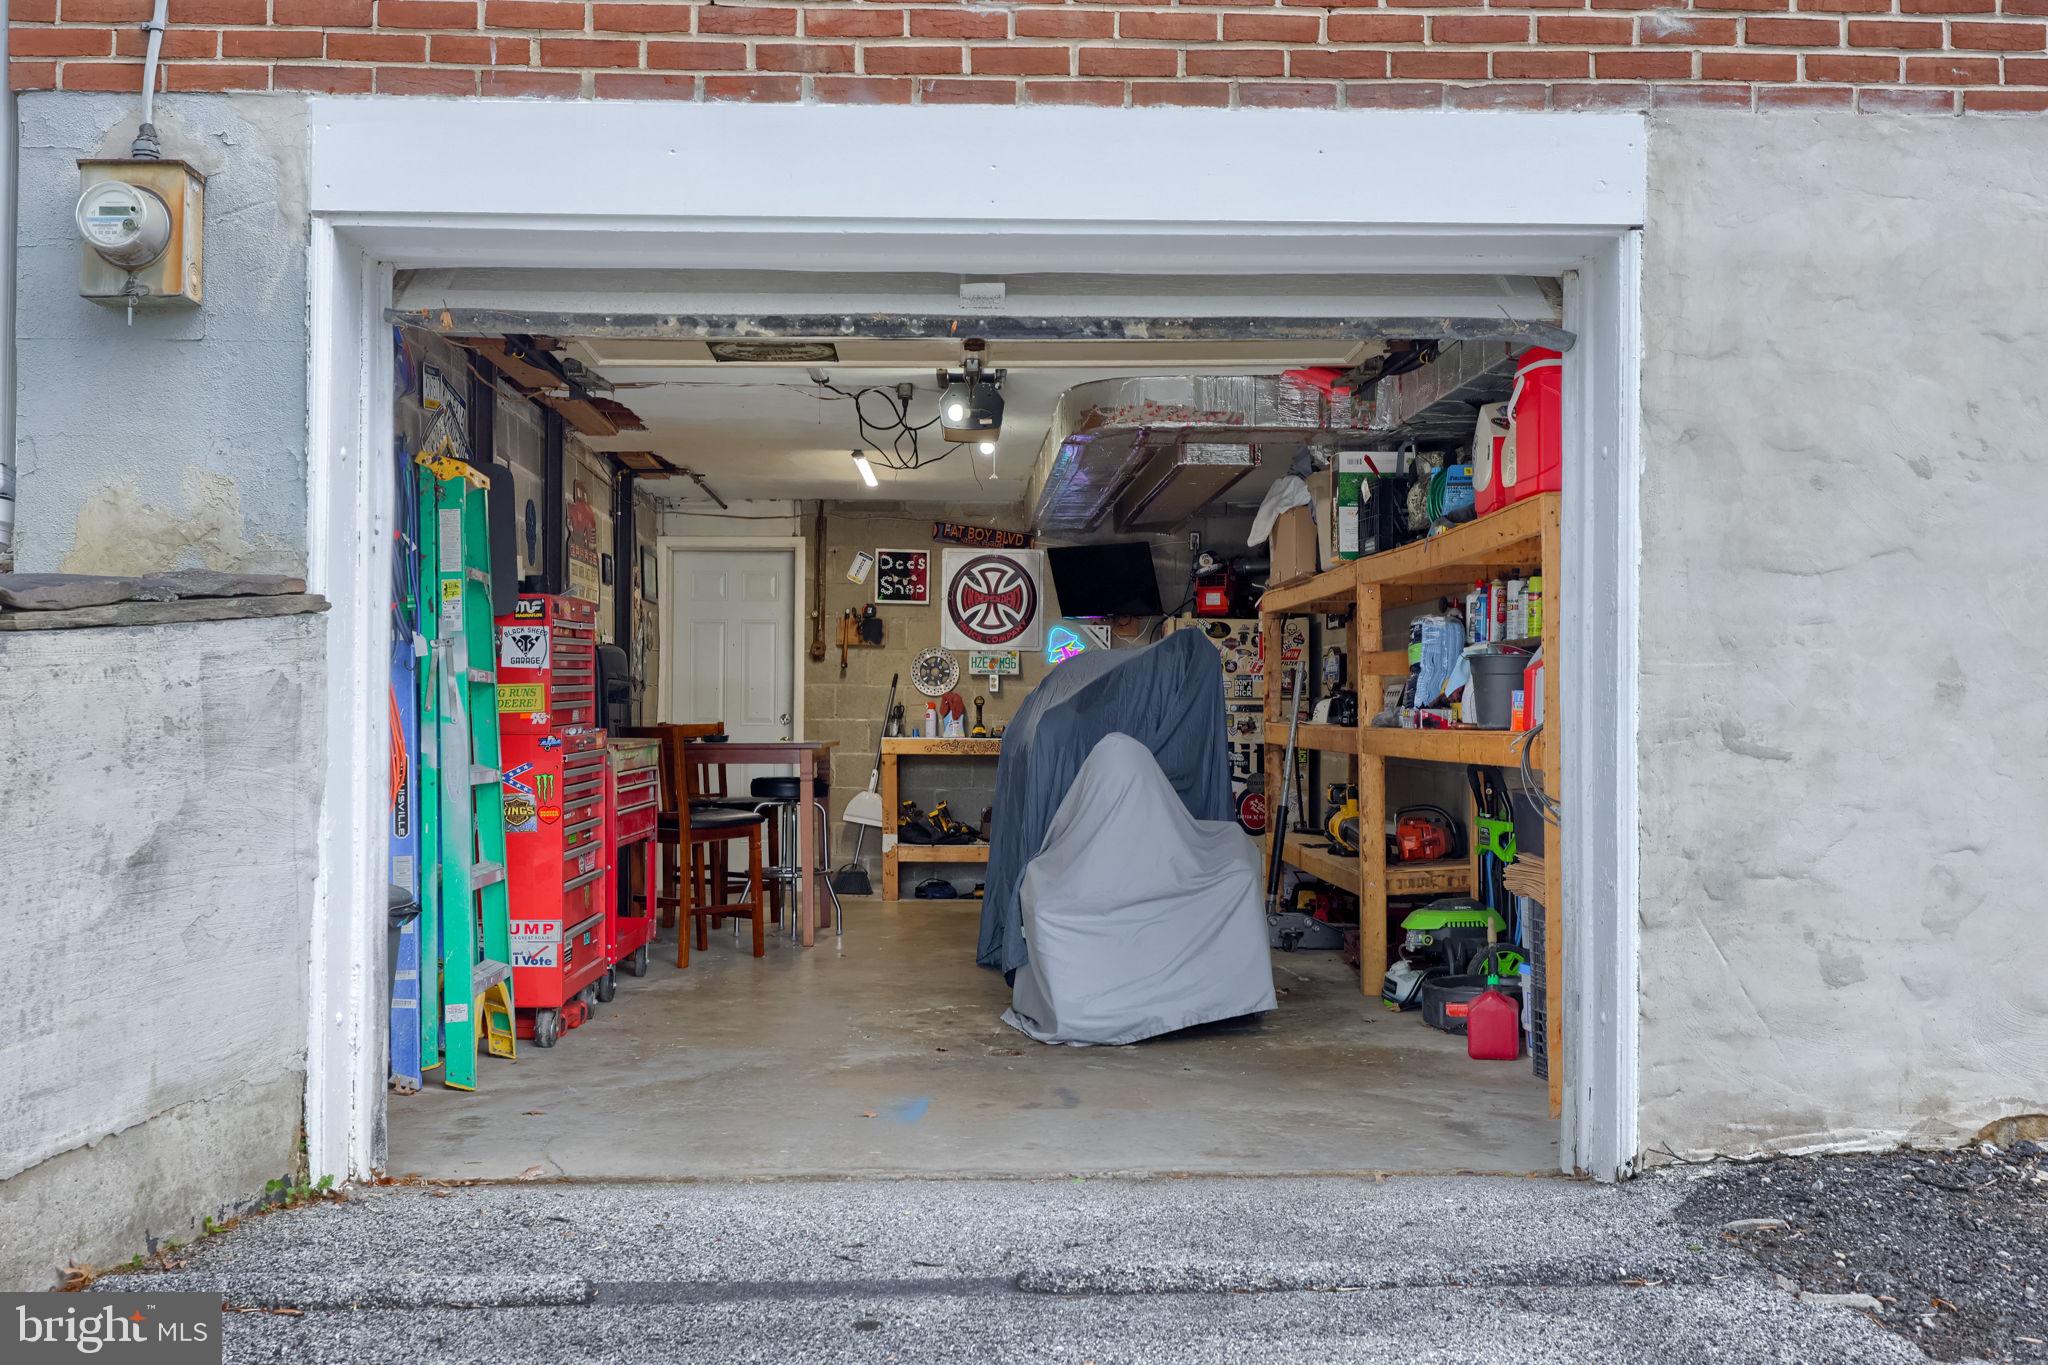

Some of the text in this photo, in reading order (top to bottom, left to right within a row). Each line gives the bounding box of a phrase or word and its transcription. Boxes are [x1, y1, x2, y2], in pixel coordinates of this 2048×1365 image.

[943, 523, 966, 538] FAT
[968, 527, 993, 541] BOY
[995, 530, 1024, 546] BLVD
[880, 575, 925, 599] Shop
[504, 627, 548, 638] BLACK SHEEP
[986, 620, 1027, 644] COMPANY
[510, 656, 541, 665] GARAGE
[509, 687, 537, 698] RUNS
[498, 698, 537, 708] DEERE!
[510, 923, 554, 935] UMP
[522, 956, 553, 966] Vote
